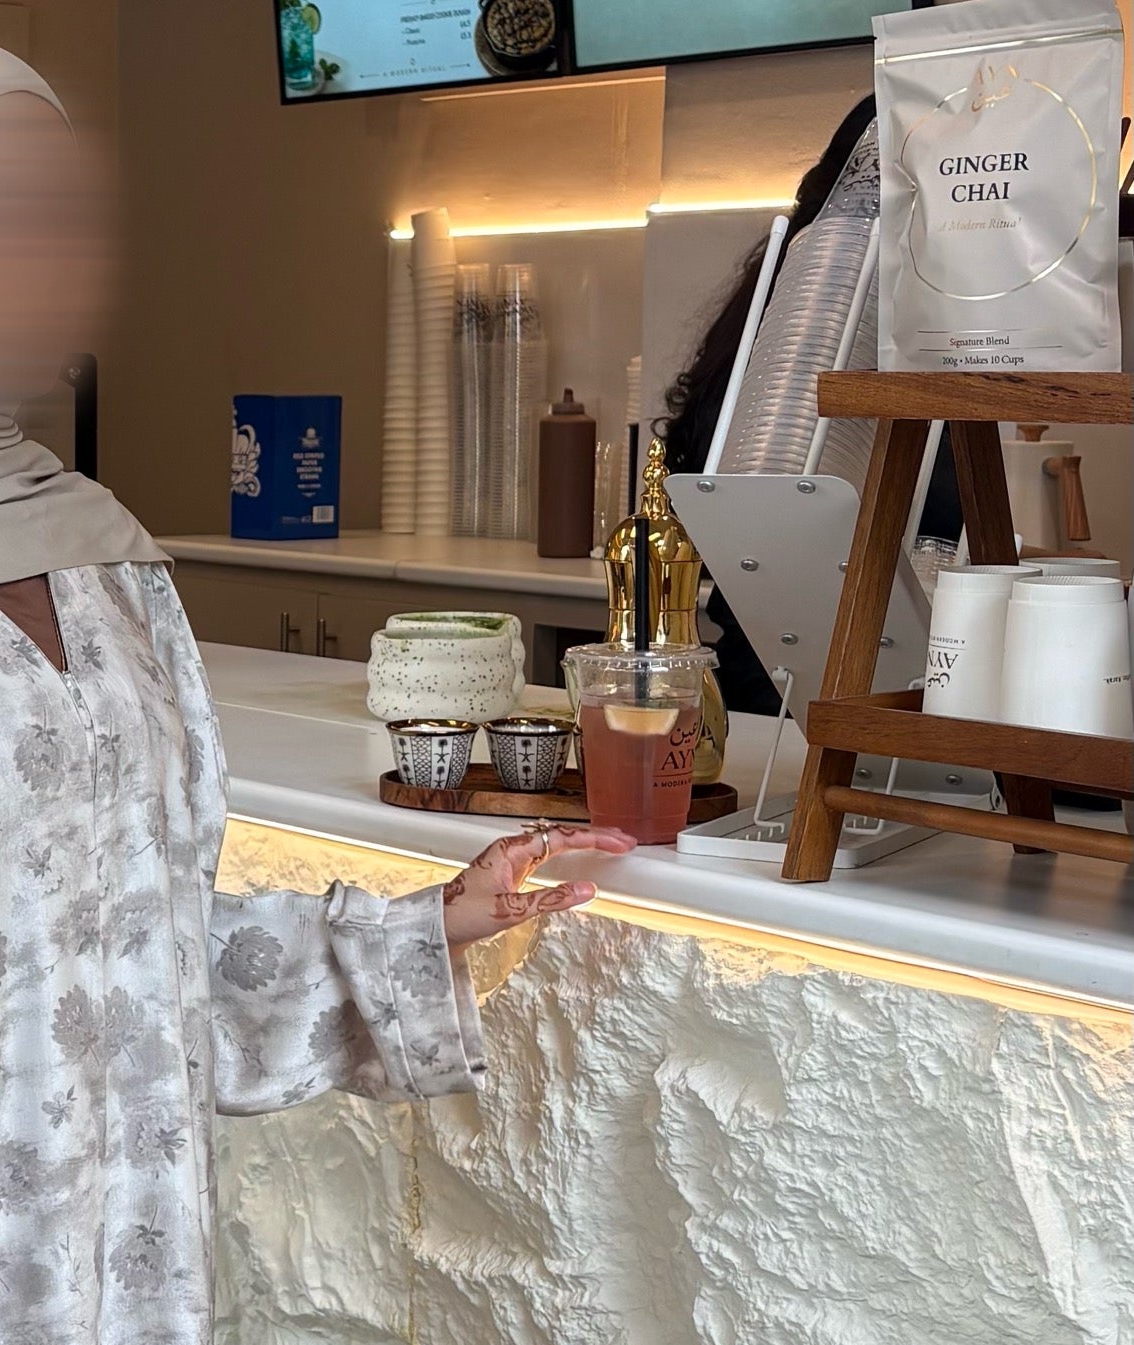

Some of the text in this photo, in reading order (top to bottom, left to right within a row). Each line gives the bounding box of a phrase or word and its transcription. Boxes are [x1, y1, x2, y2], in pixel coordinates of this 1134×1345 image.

[939, 152, 1029, 176] GINGER
[951, 180, 1011, 203] CHAI
[949, 336, 1009, 348] Signature Blend
[942, 355, 1024, 367] 200g Makes 10 Cups
